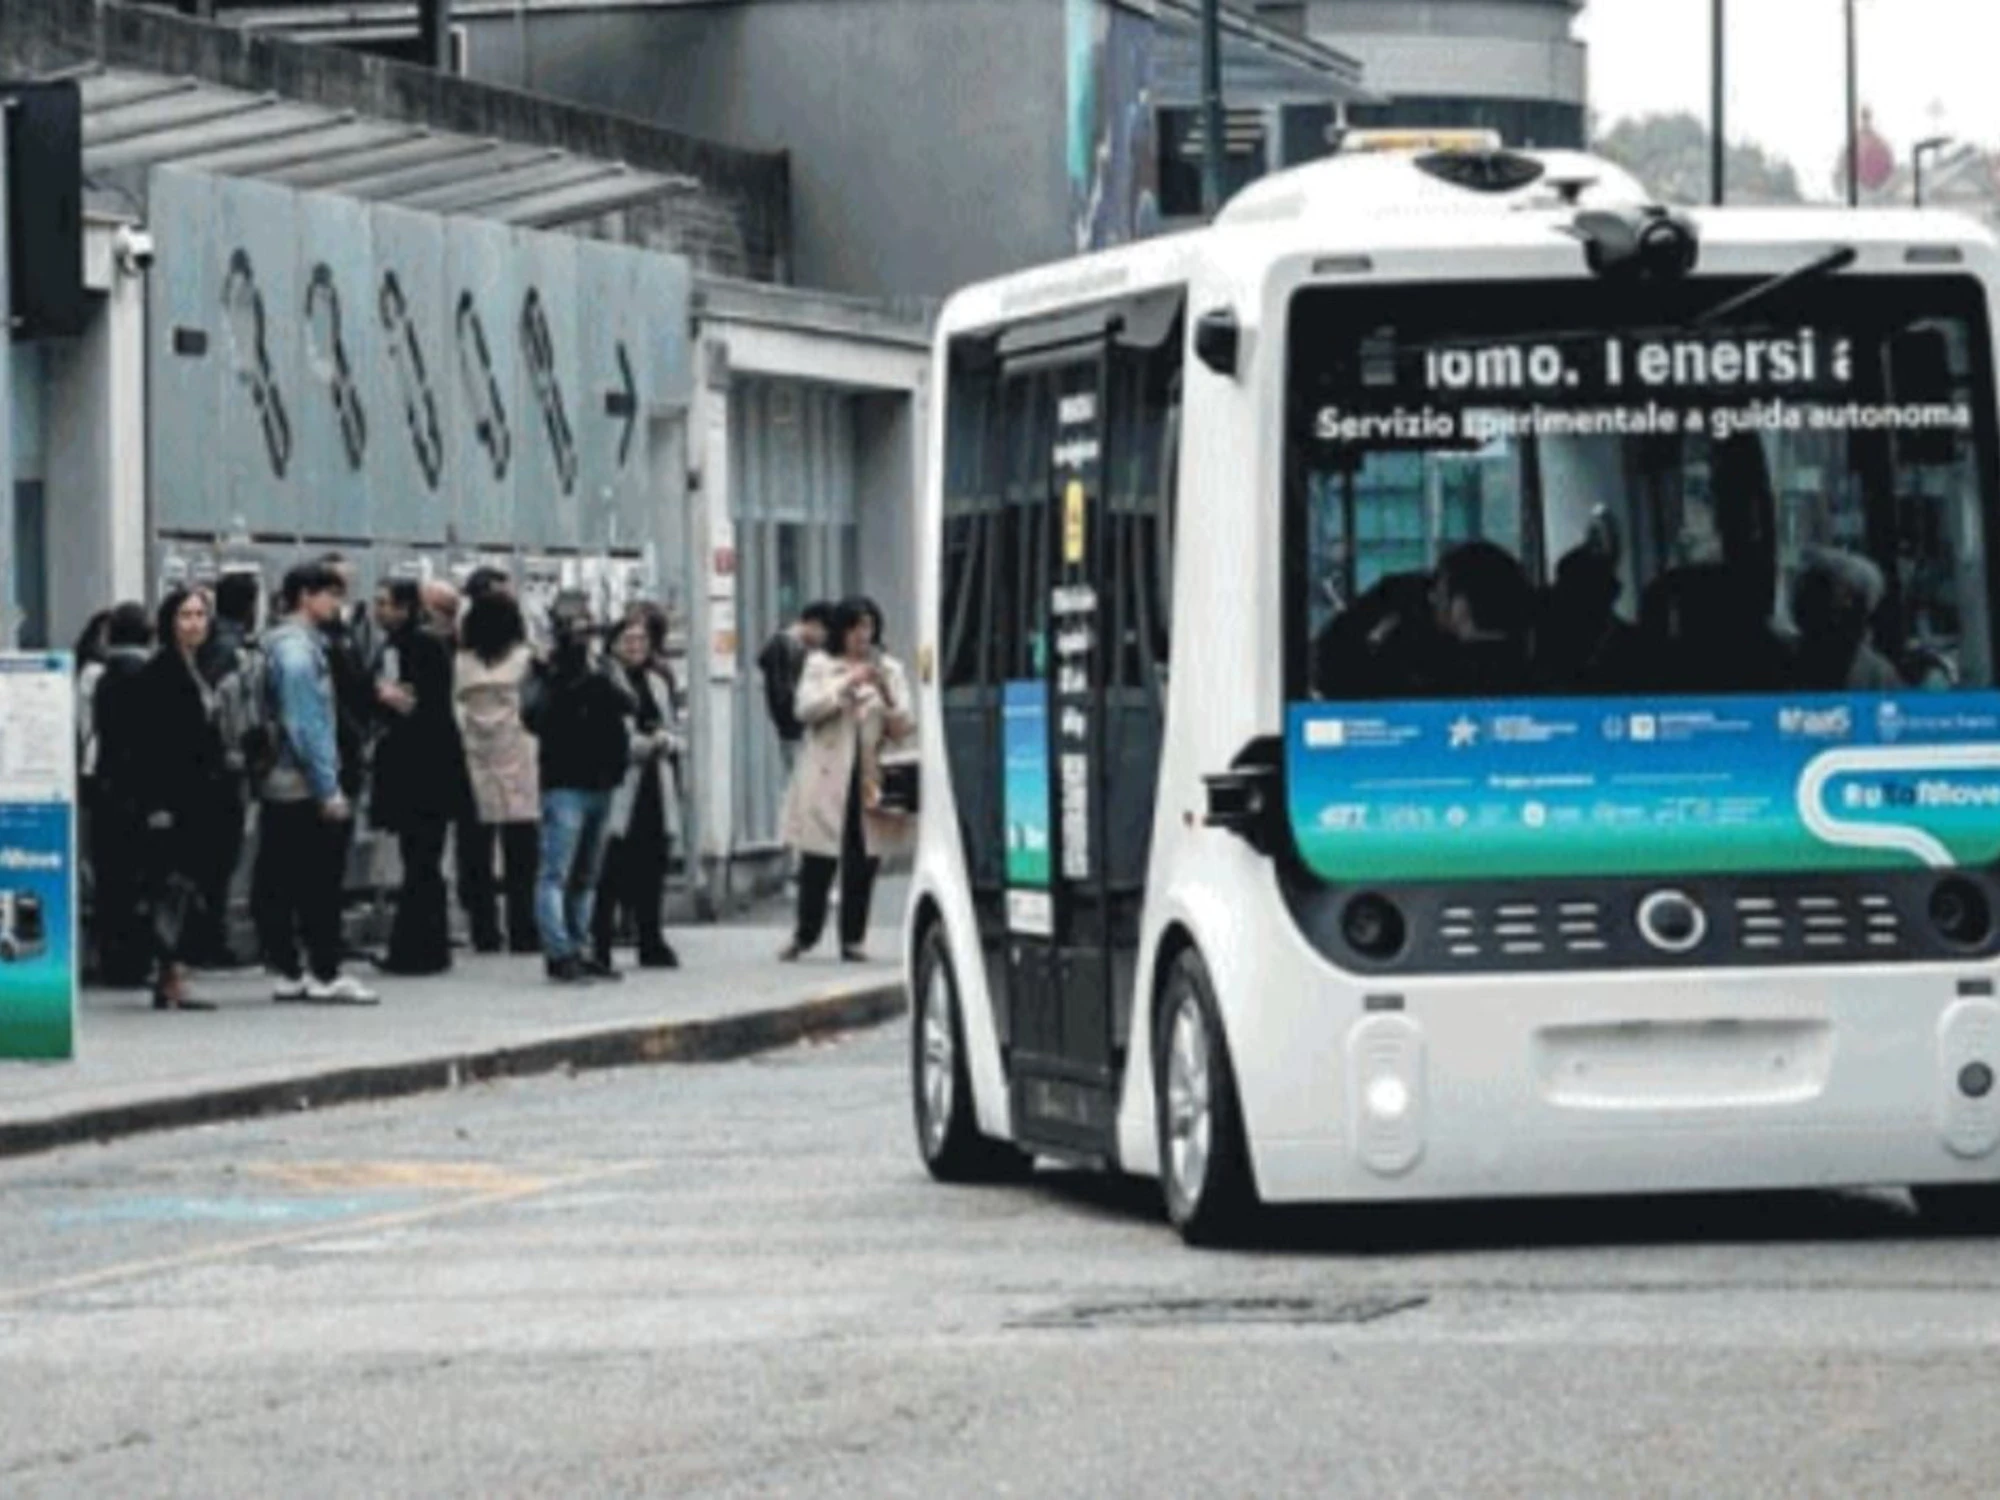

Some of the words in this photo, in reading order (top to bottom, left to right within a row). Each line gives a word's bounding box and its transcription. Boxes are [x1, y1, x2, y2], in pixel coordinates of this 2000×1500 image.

[1316, 404, 1454, 440] Servizio
[1684, 408, 1705, 433] a
[1711, 397, 1802, 440] guida
[1807, 402, 1971, 431] autonoma
